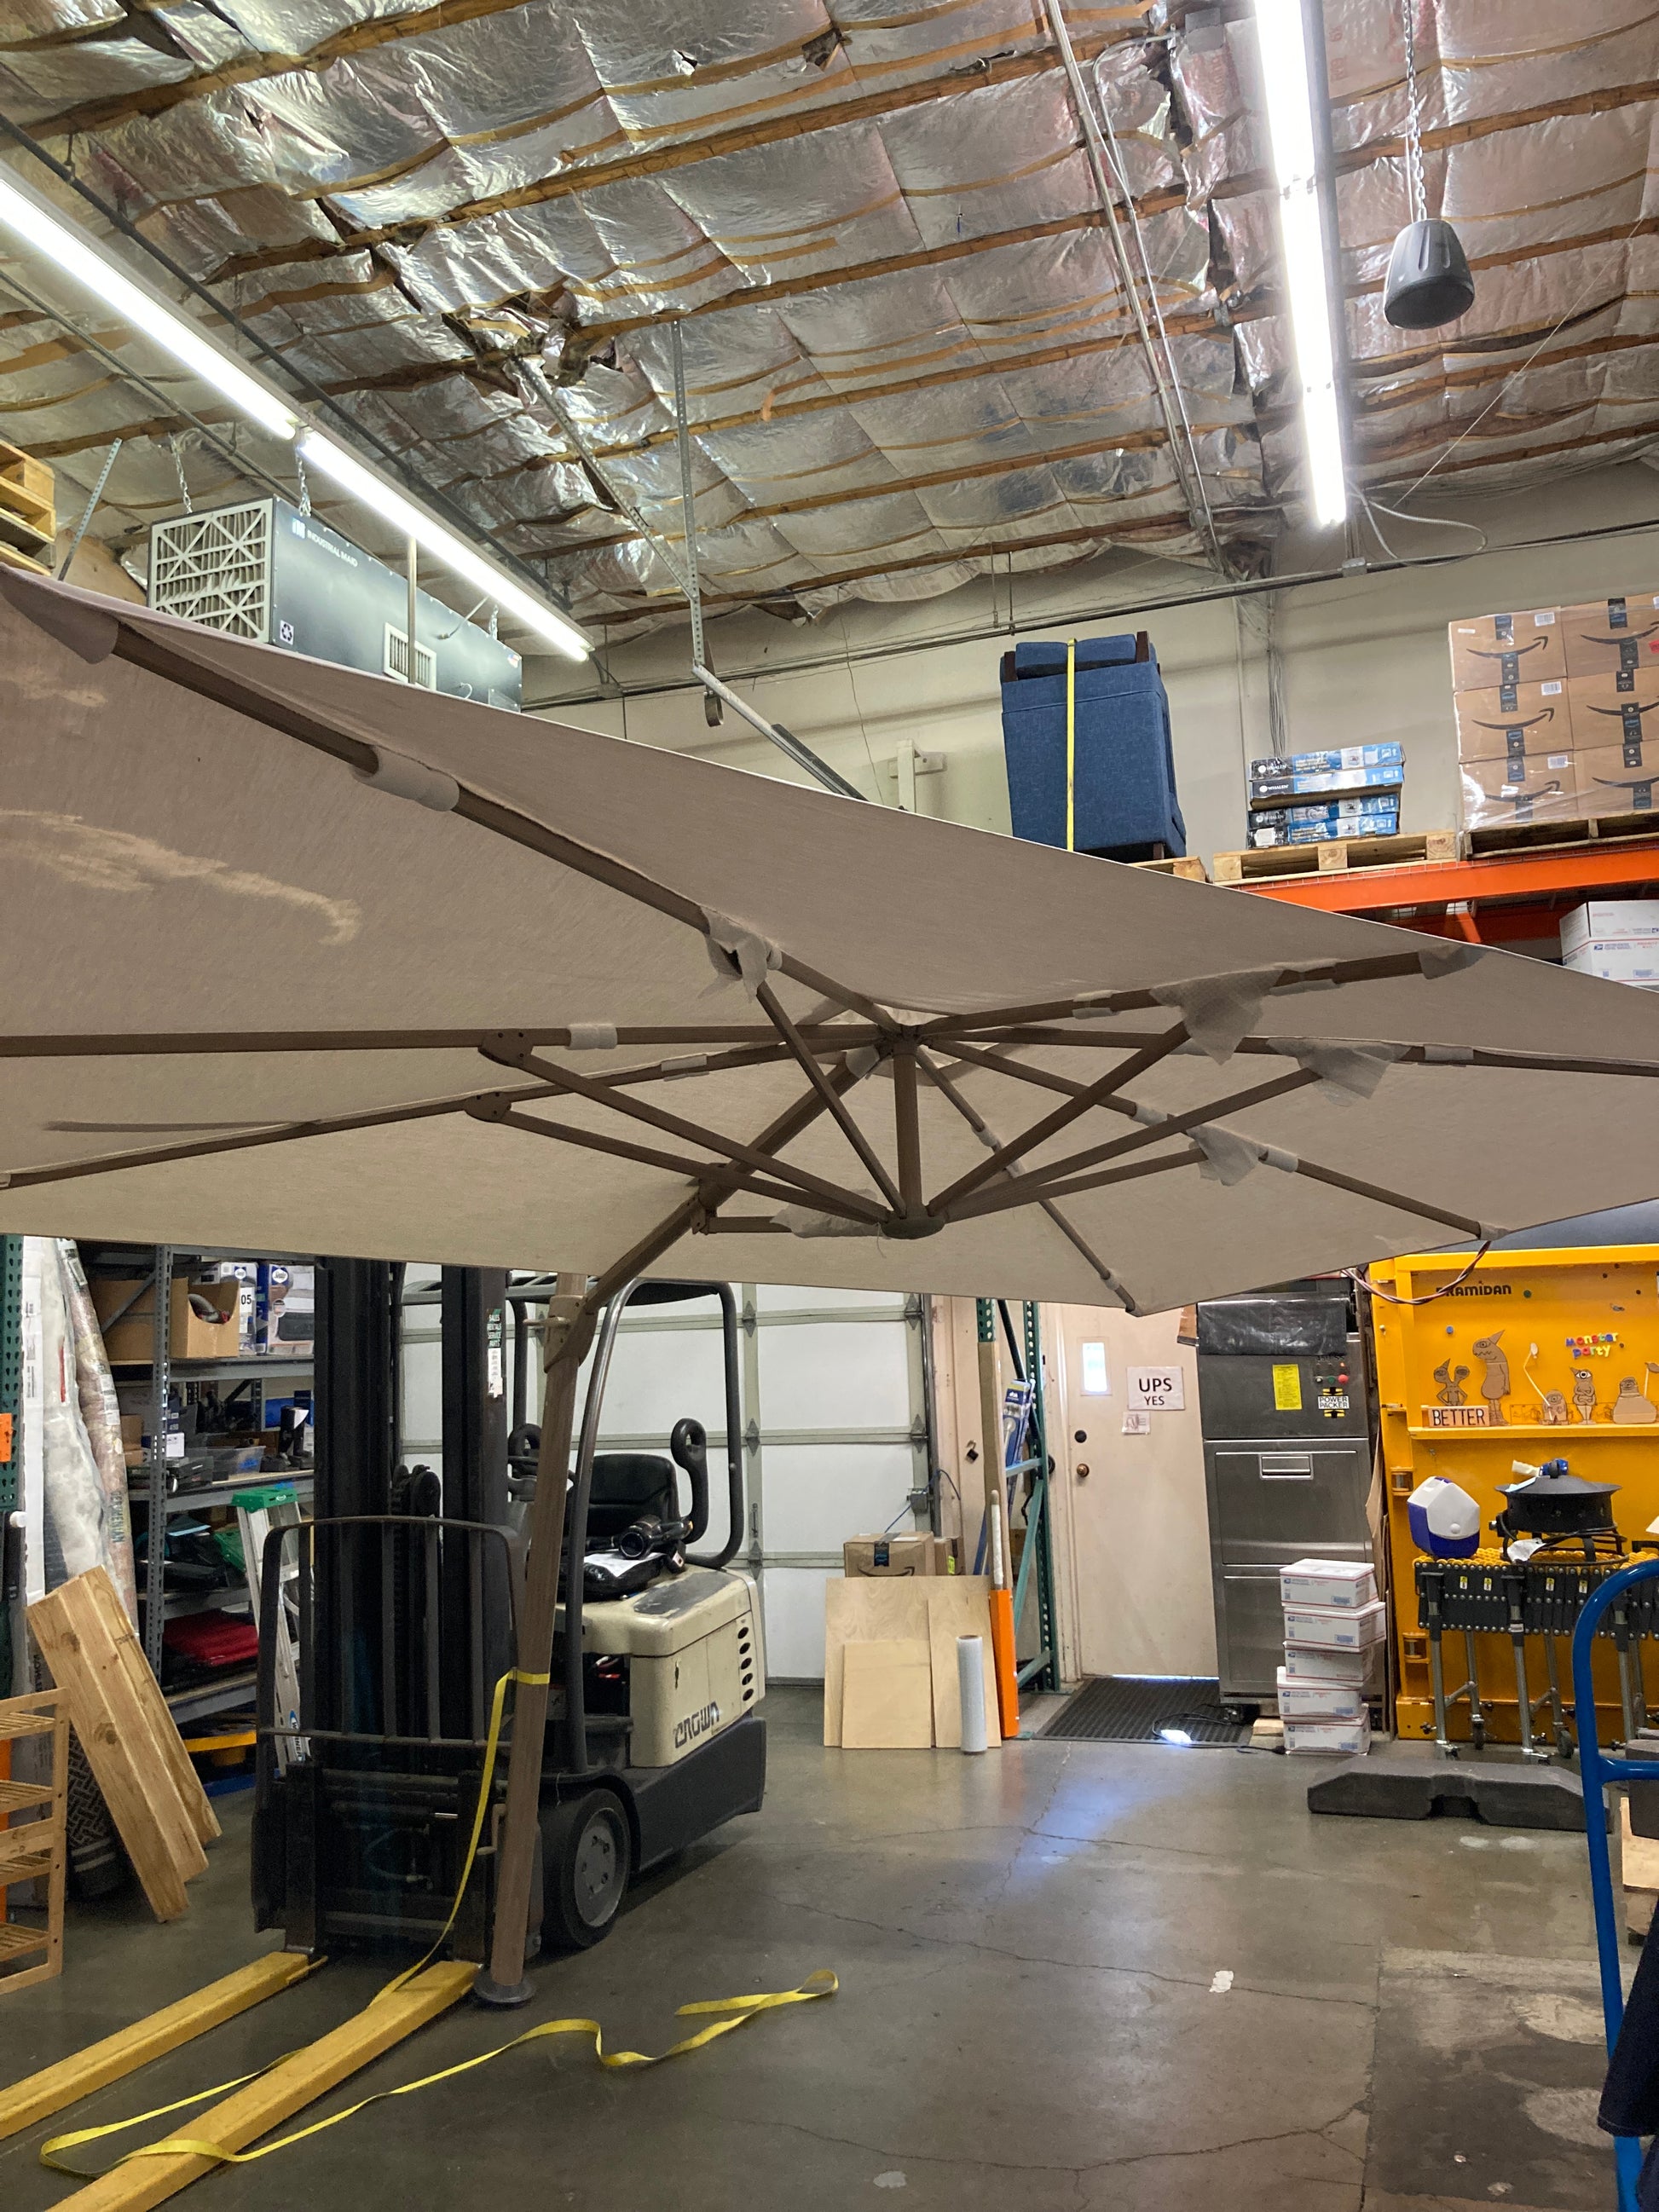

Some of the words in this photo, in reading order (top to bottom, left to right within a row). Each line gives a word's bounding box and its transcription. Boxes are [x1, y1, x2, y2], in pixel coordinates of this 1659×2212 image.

[240, 1294, 251, 1304] 05
[1139, 1377, 1172, 1392] UPS
[1144, 1395, 1165, 1406] YES
[1432, 1408, 1485, 1425] BETTER
[674, 1701, 720, 1748] CROWN
